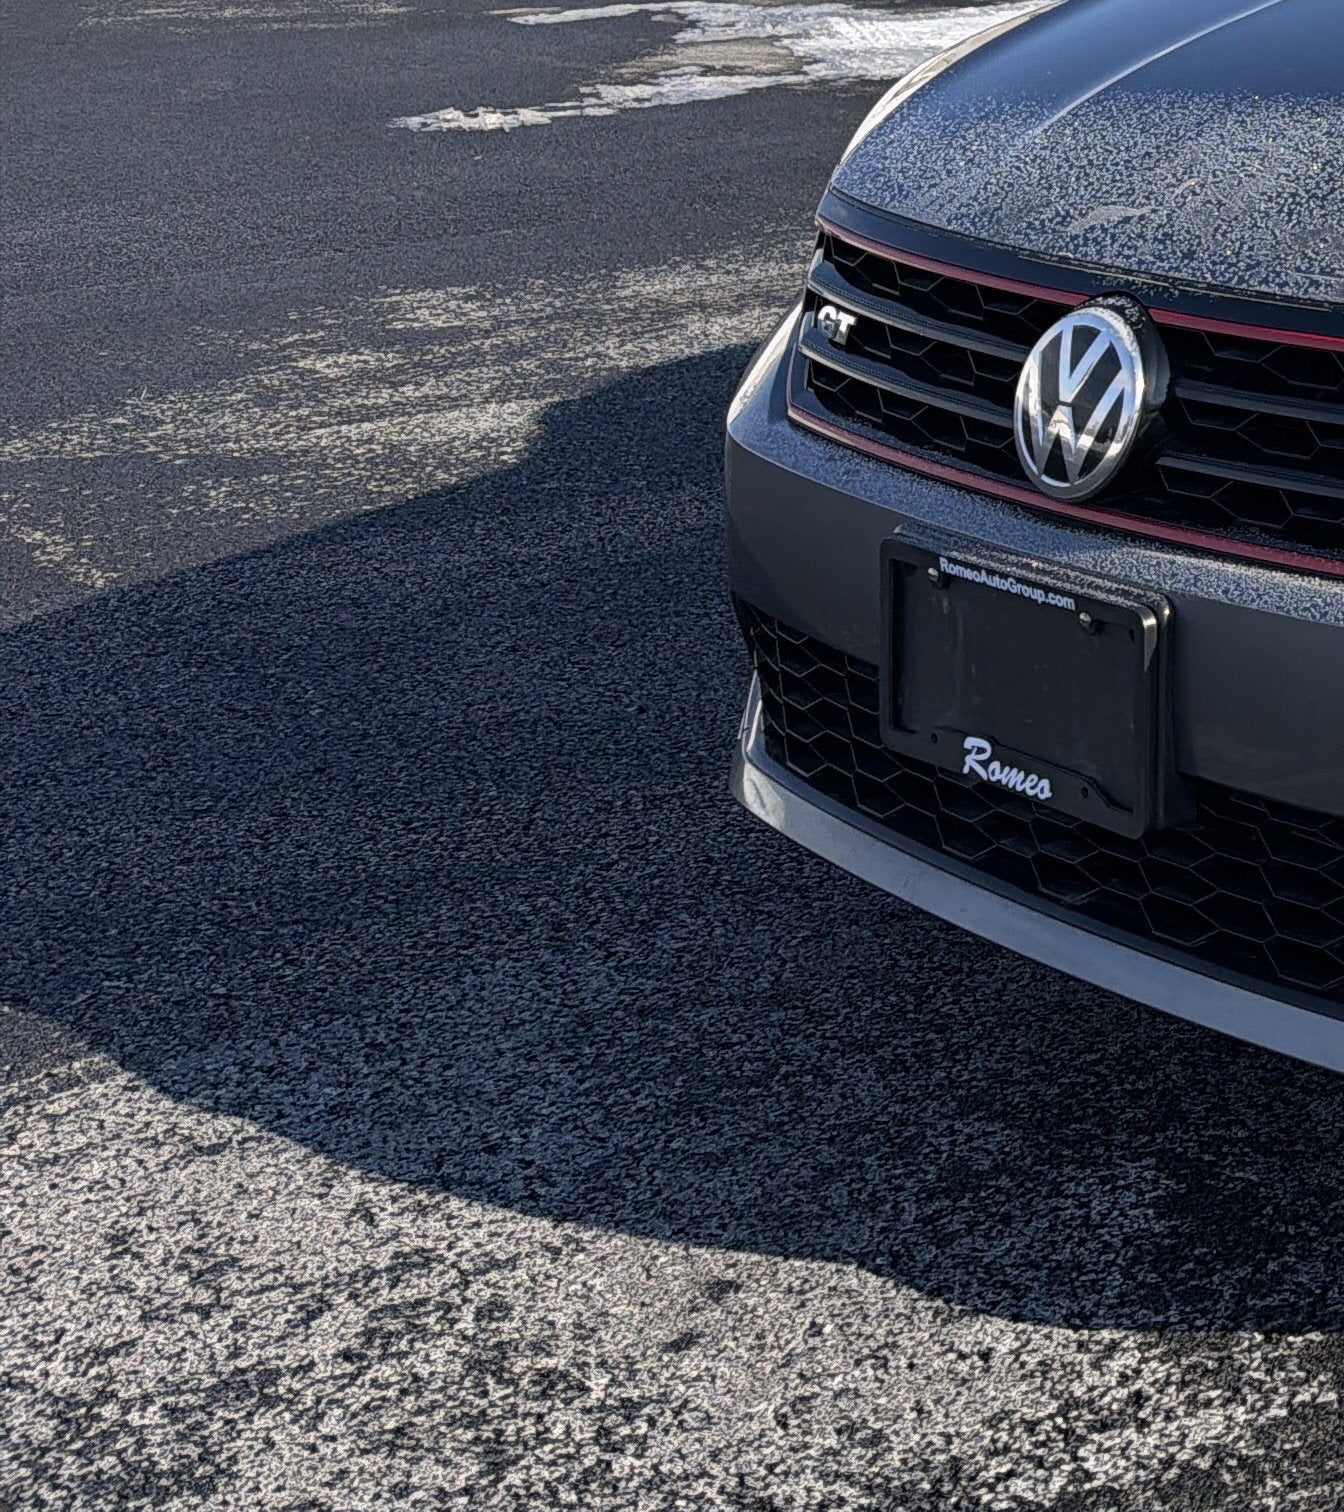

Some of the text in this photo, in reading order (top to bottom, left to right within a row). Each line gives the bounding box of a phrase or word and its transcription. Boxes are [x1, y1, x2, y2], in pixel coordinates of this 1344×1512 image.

[817, 305, 858, 346] GT
[1015, 308, 1145, 501] VW
[938, 556, 1077, 612] RomeoAutoGroup.com
[962, 736, 1053, 800] Romeo
